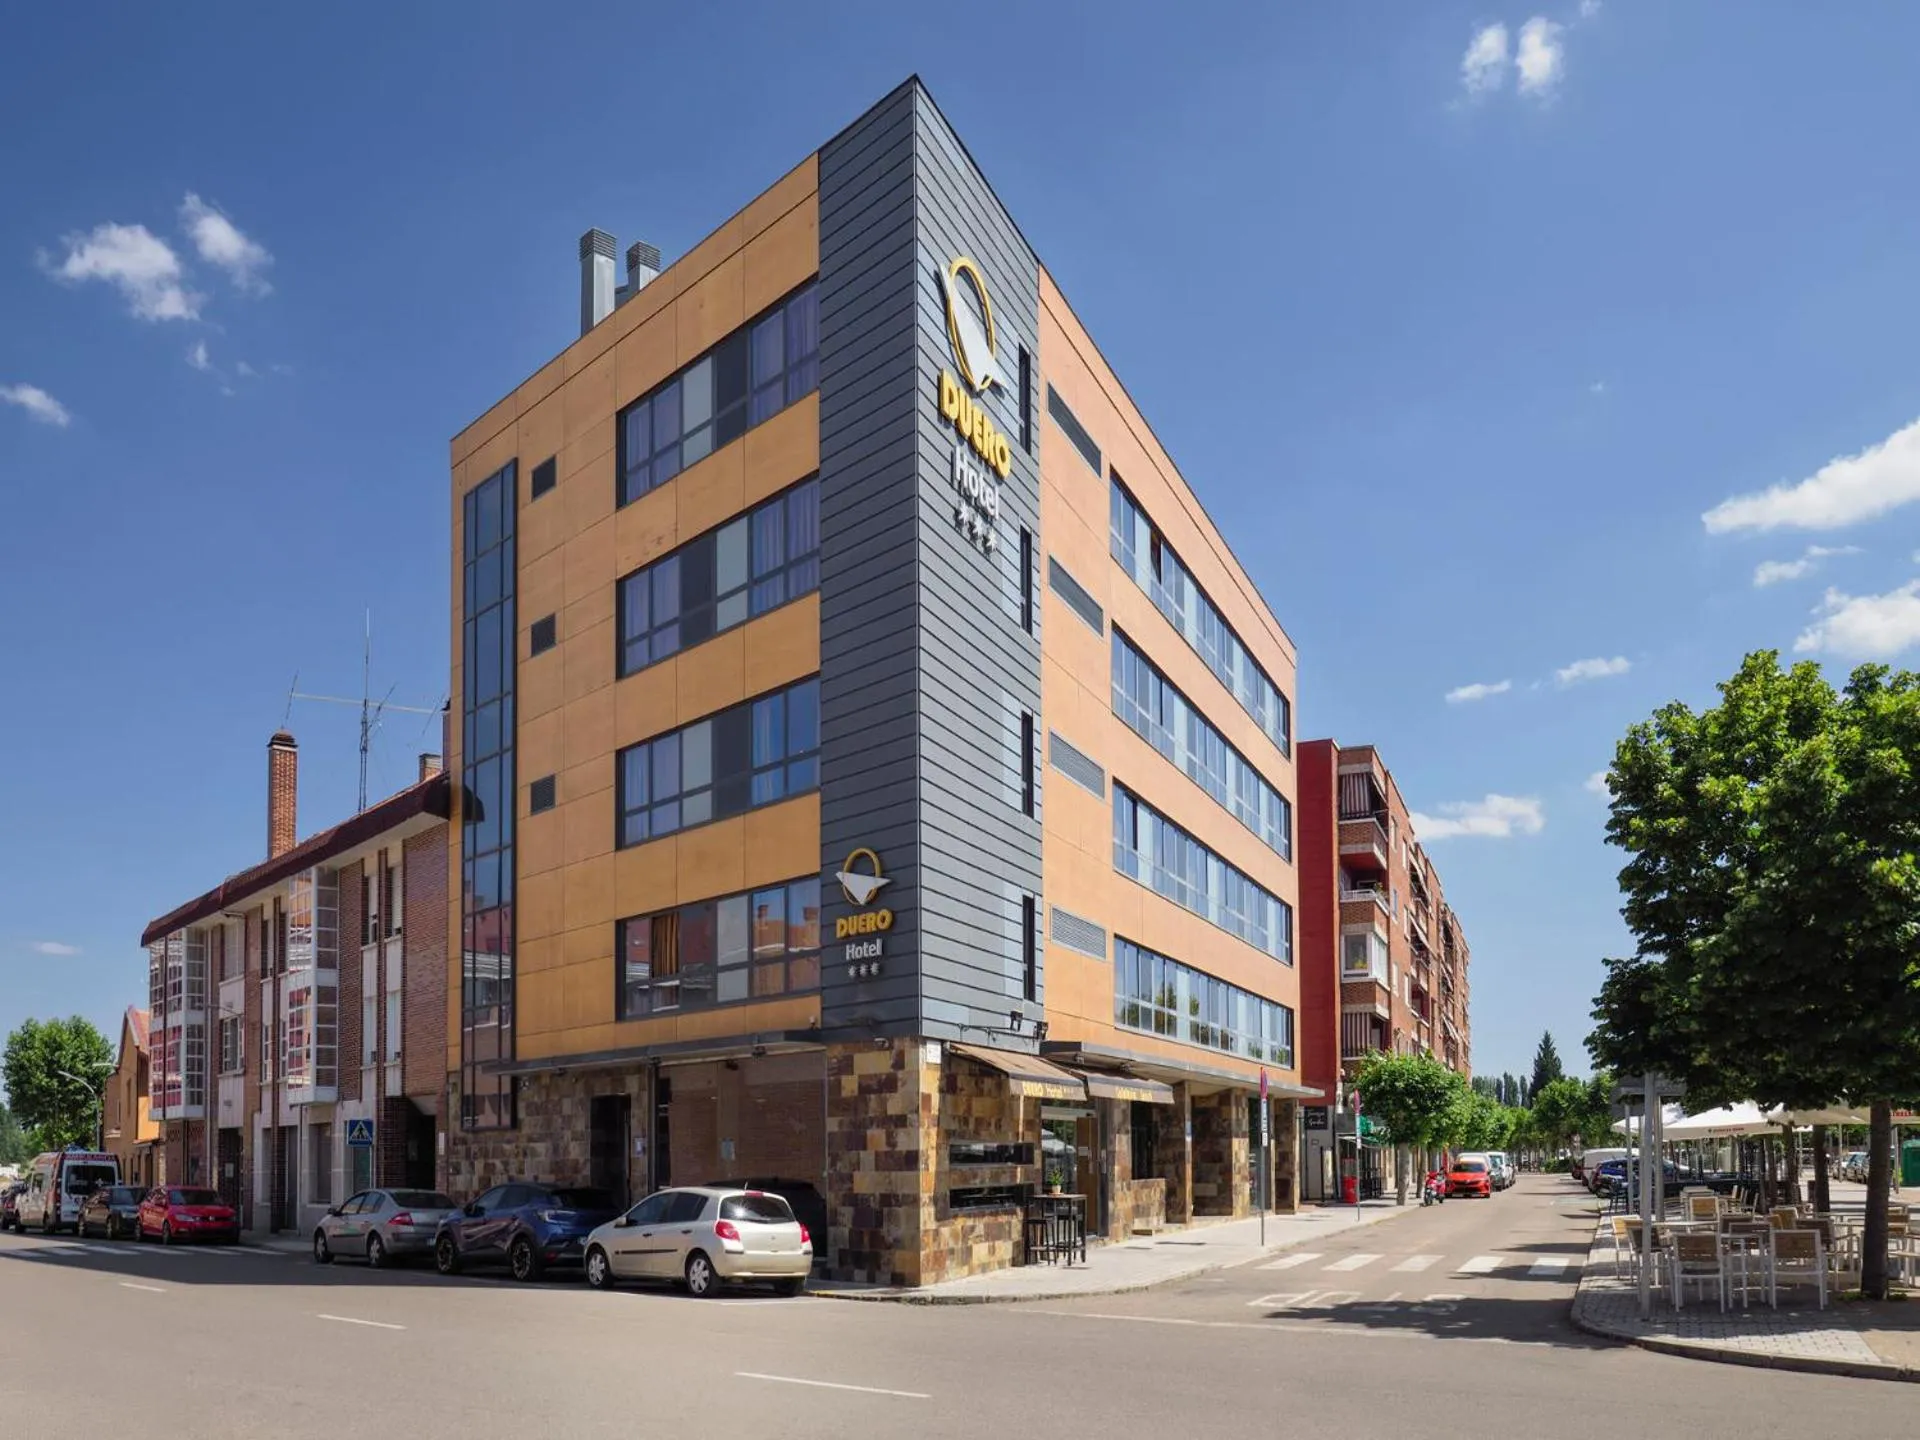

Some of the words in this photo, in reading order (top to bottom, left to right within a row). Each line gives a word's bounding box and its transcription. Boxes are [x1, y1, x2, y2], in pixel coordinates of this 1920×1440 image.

[939, 368, 1011, 479] DUERO
[954, 446, 999, 520] Hotel
[836, 908, 893, 939] DUERO
[845, 938, 883, 961] Hotel
